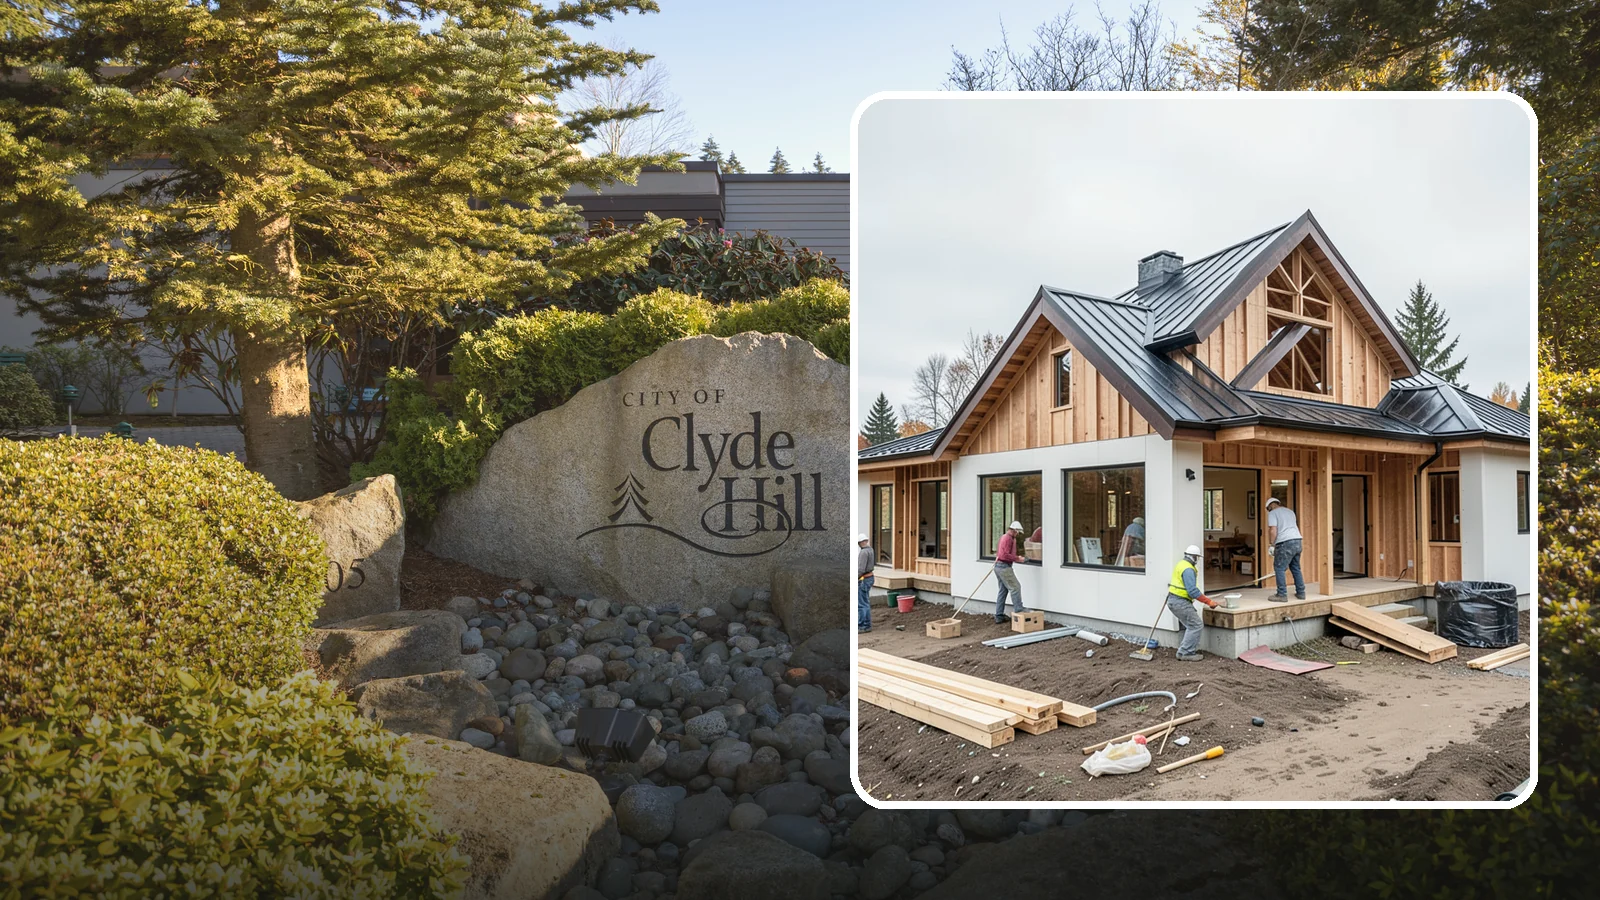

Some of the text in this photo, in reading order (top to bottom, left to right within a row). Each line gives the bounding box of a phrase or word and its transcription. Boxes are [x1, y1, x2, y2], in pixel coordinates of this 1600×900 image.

[623, 389, 725, 407] CITY OF
[642, 411, 795, 493] Clyde
[719, 472, 828, 532] Hill
